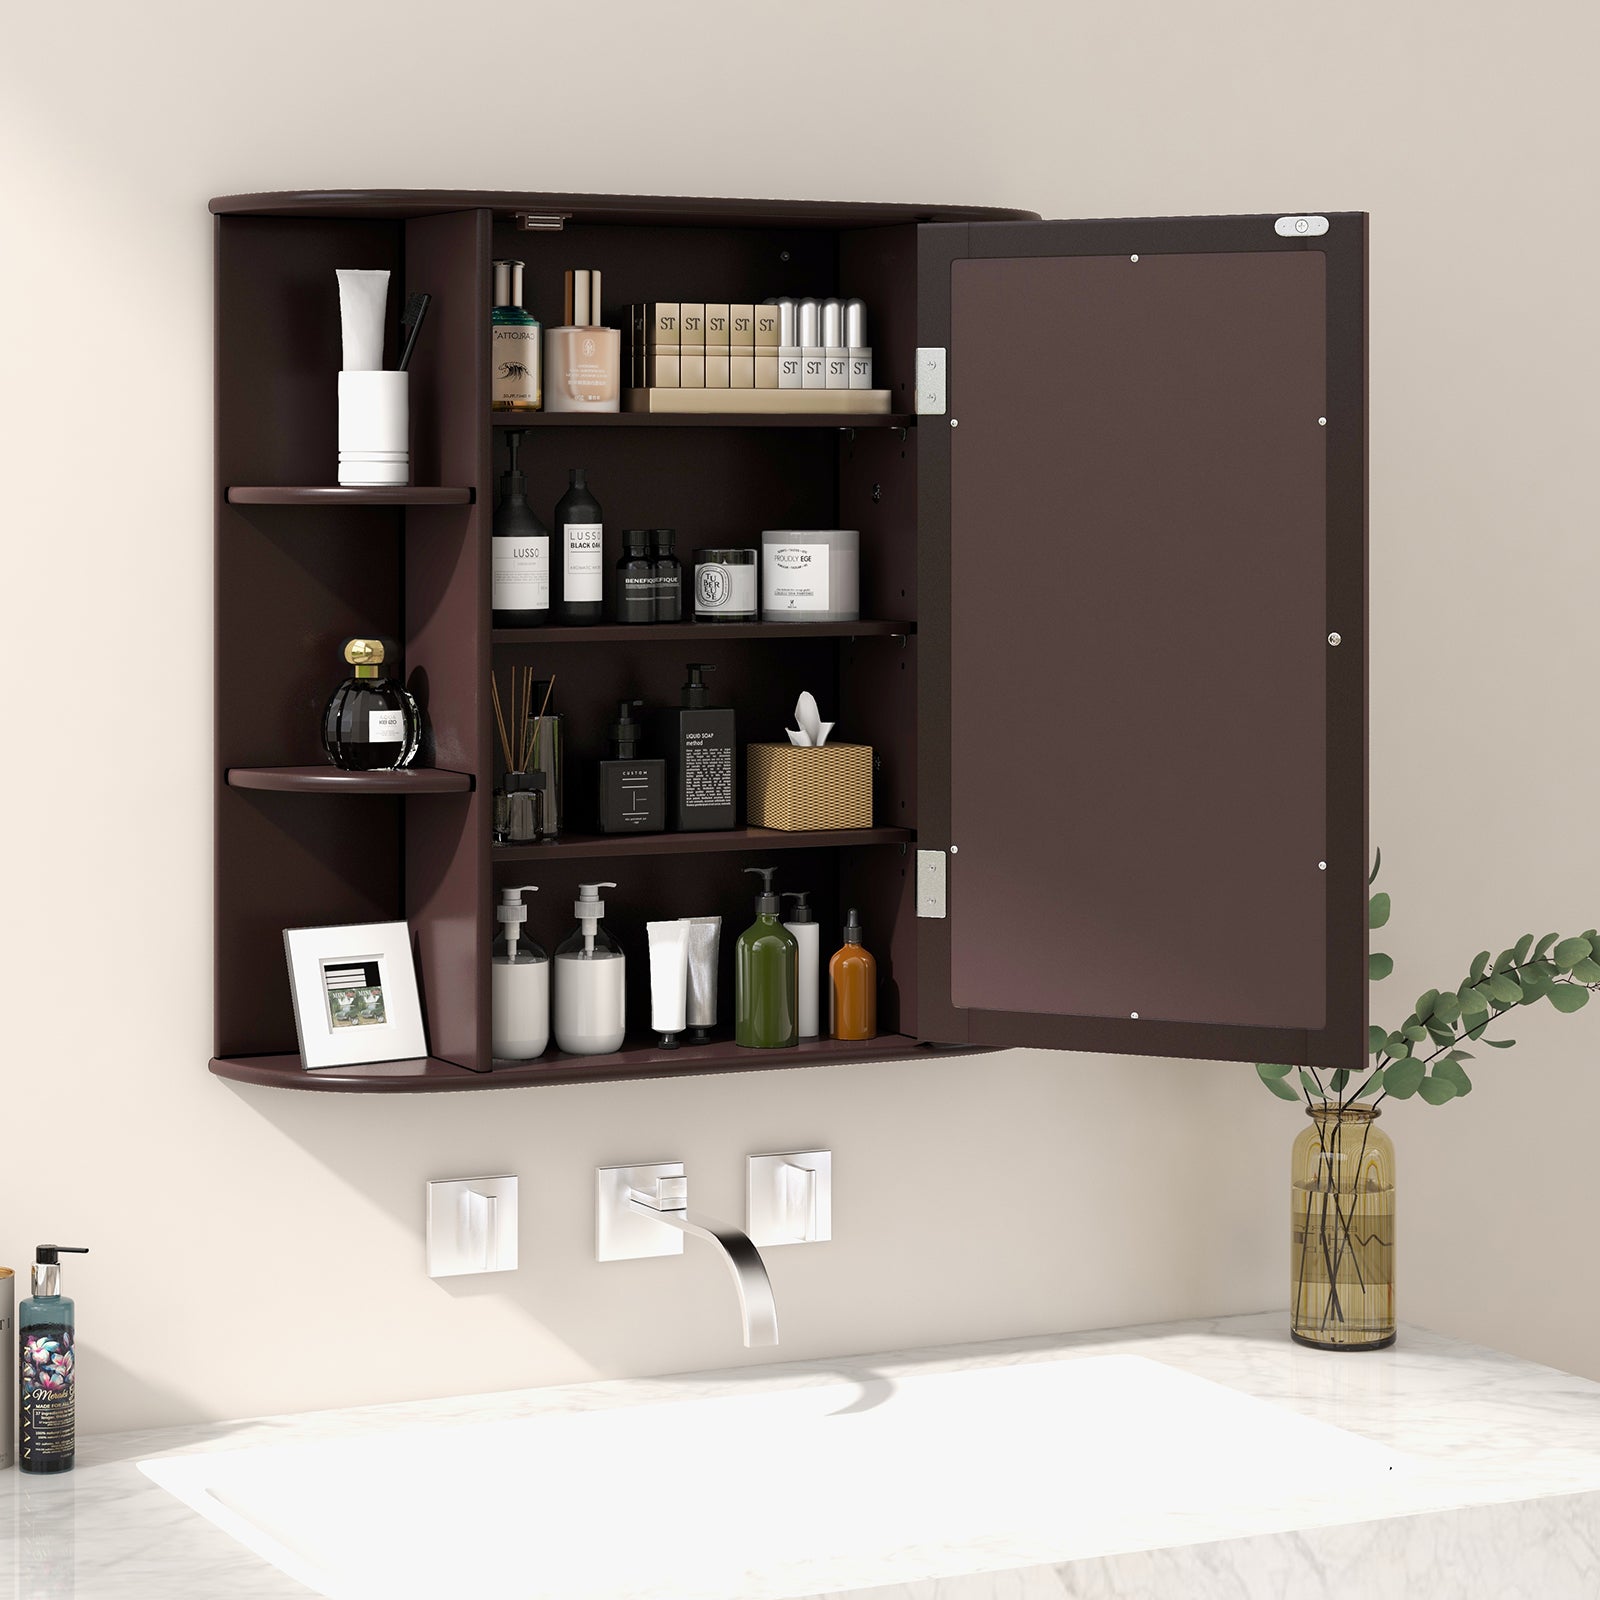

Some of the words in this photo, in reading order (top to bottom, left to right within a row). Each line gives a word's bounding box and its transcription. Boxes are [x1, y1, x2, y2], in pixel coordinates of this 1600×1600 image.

[661, 317, 676, 330] ST
[686, 317, 701, 330] ST
[711, 317, 726, 330] ST
[736, 318, 750, 331] ST
[760, 319, 775, 331] ST
[783, 361, 798, 374] ST
[807, 361, 822, 374] ST
[830, 361, 846, 374] ST
[854, 361, 869, 375] ST
[513, 548, 540, 558] LUSSO
[800, 555, 812, 563] EGE
